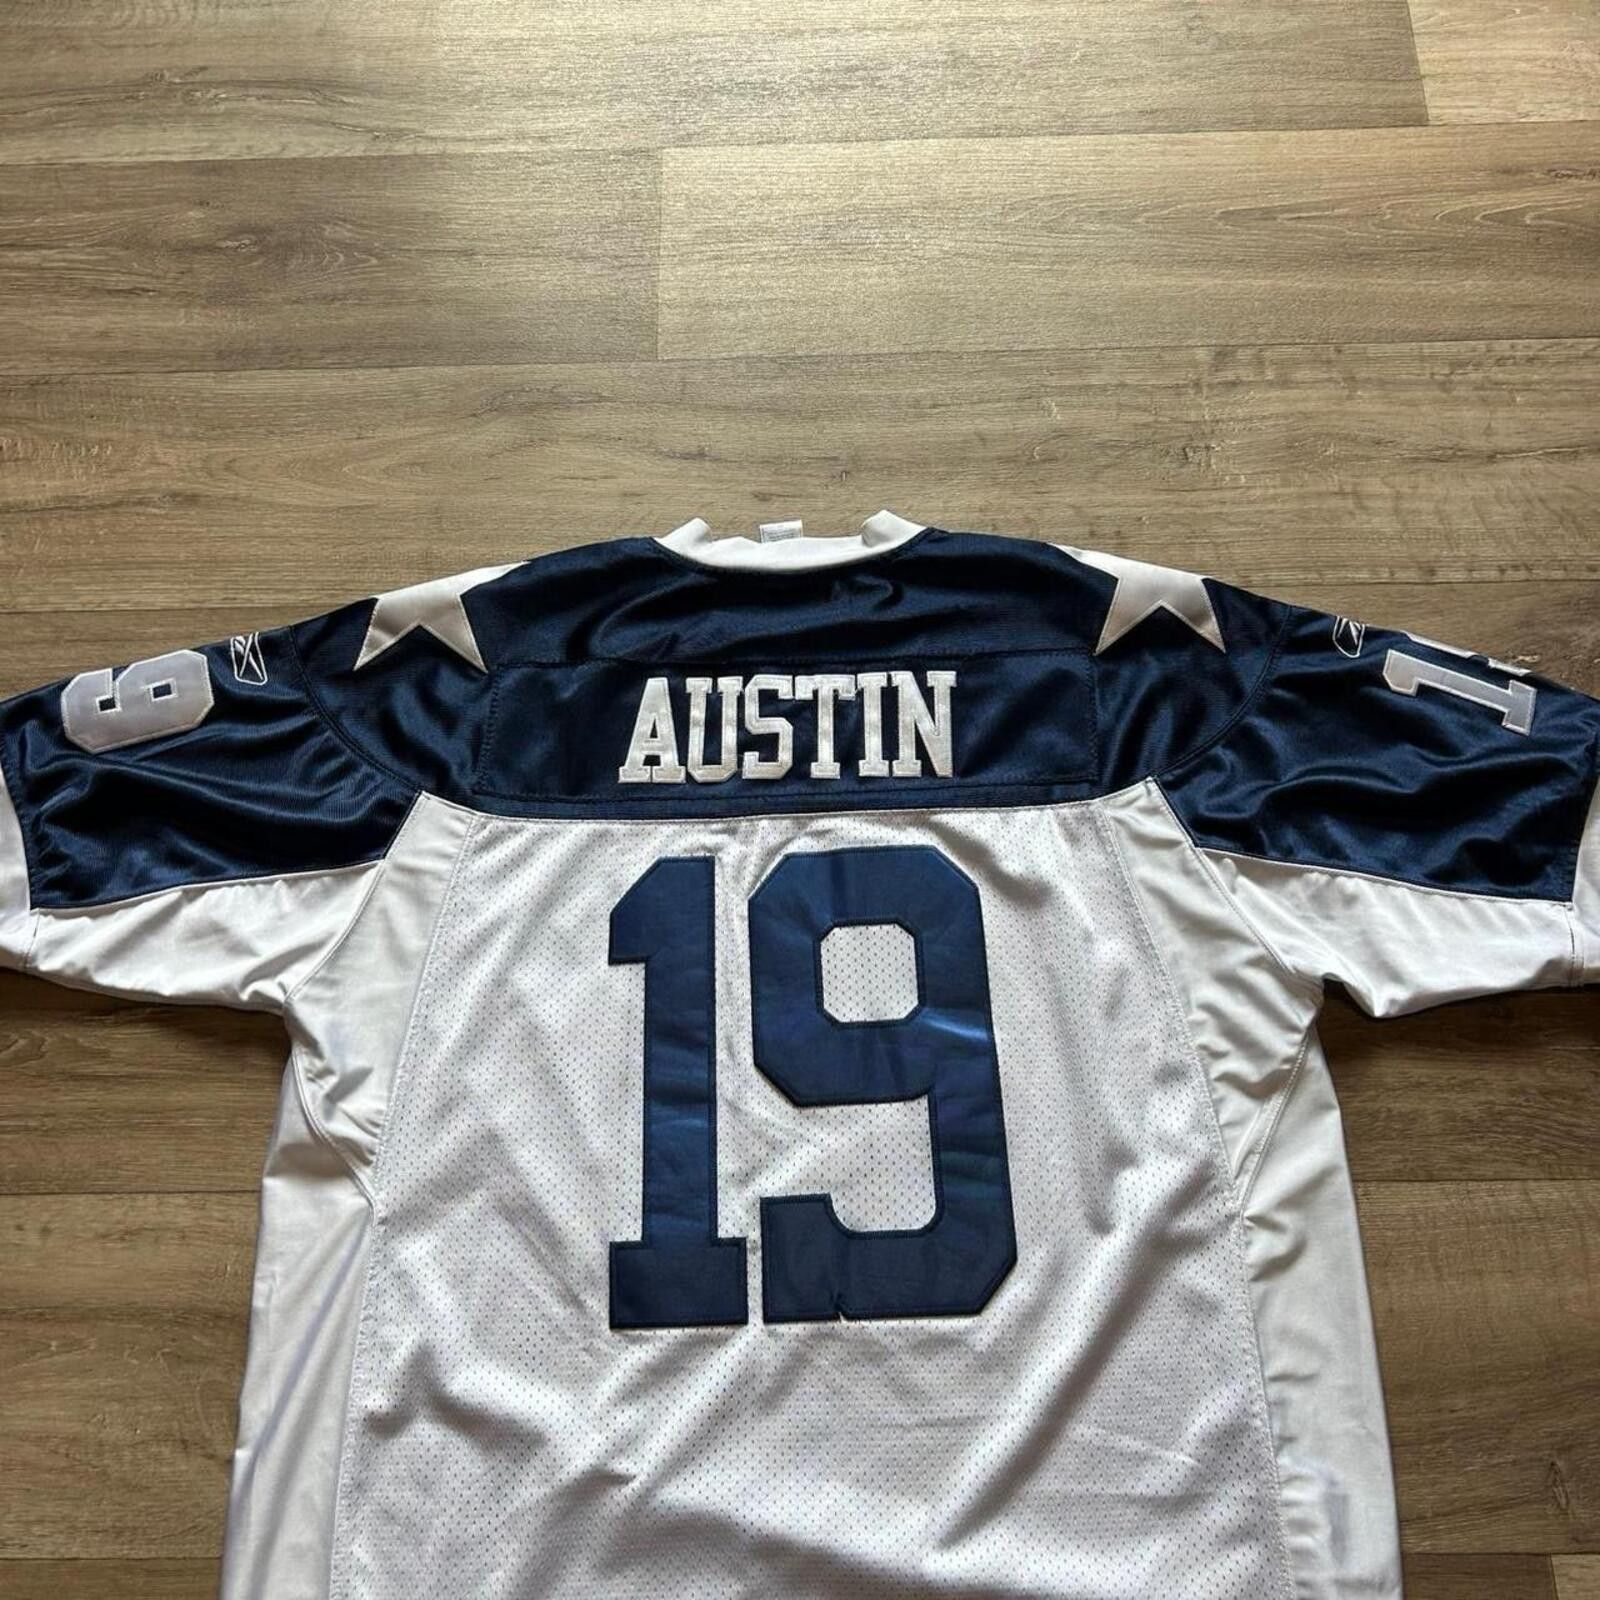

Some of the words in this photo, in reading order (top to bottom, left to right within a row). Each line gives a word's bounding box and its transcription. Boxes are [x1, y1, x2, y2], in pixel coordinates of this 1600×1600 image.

[618, 671, 957, 784] AUSTIN
[1383, 630, 1538, 736] 1
[608, 844, 1018, 1330] 19
